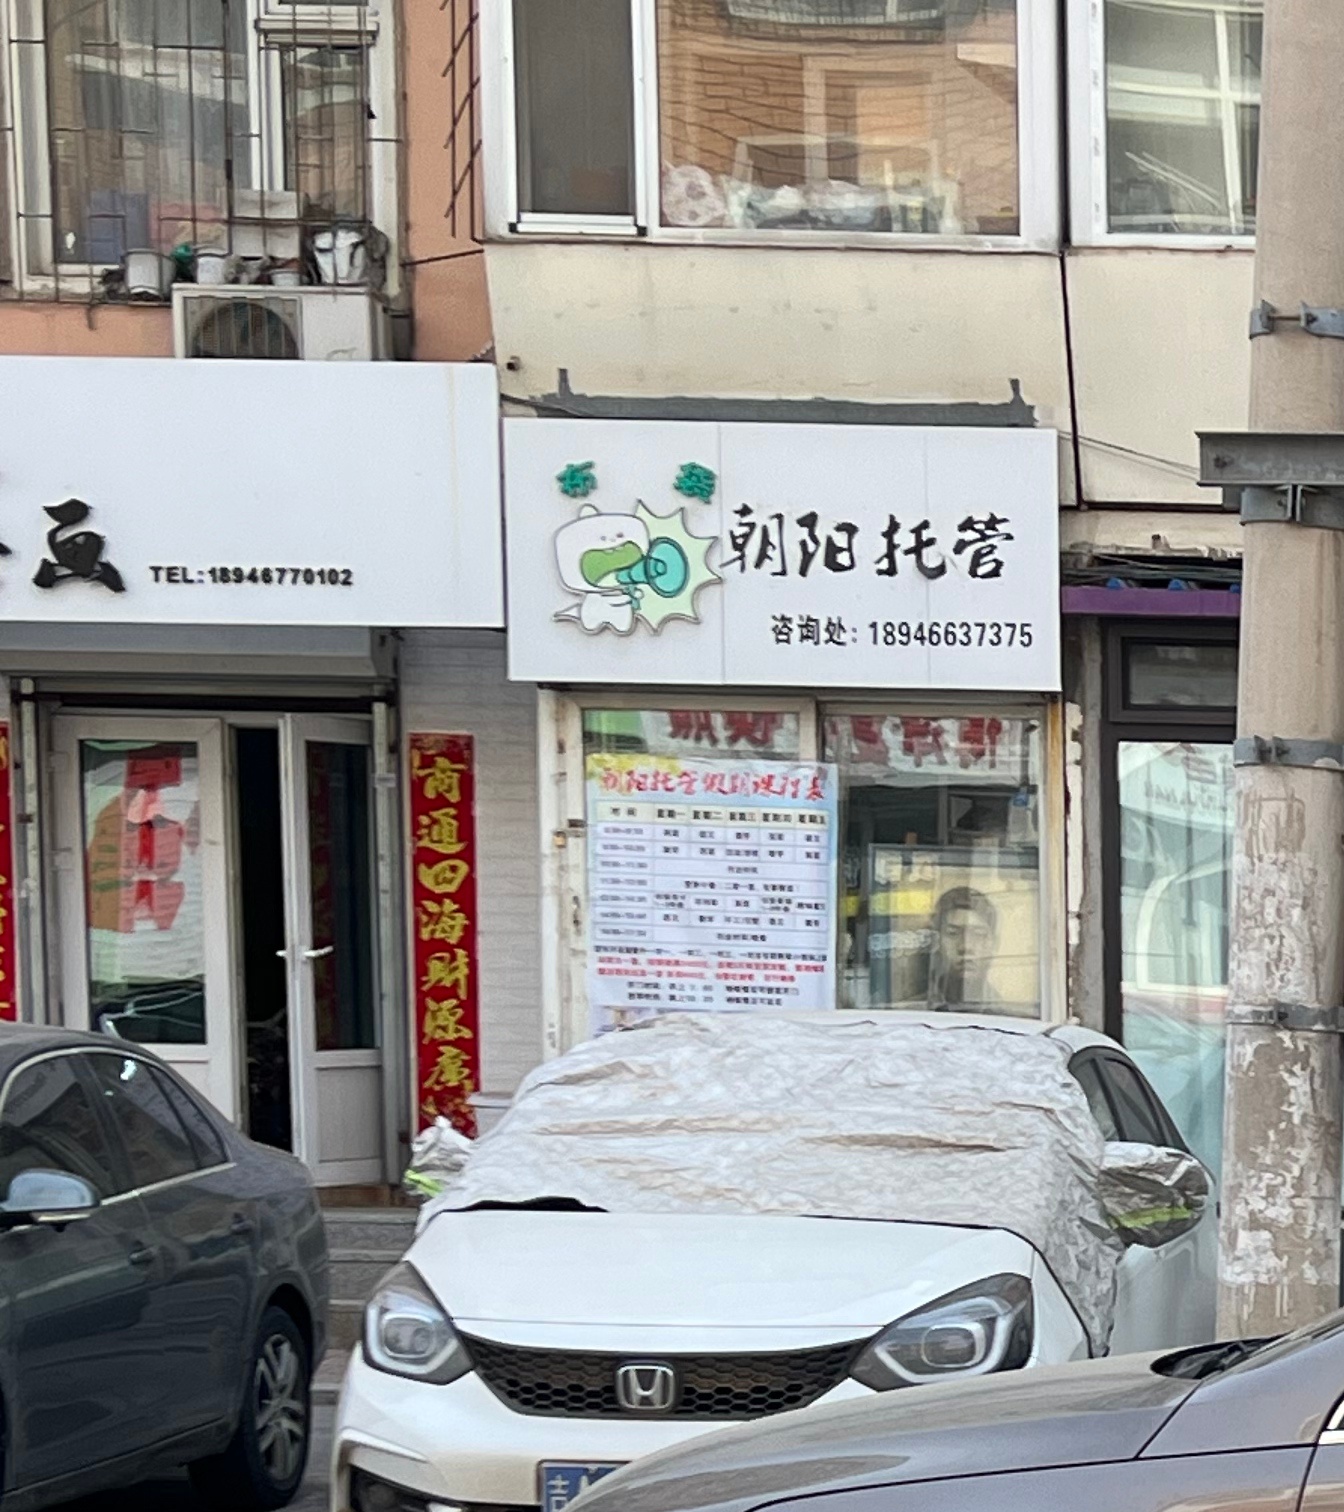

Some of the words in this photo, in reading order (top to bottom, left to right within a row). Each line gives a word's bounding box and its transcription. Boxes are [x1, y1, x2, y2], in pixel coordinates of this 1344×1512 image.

[720, 503, 1015, 580] 朝阳托管
[869, 621, 1034, 648] 18946637375
